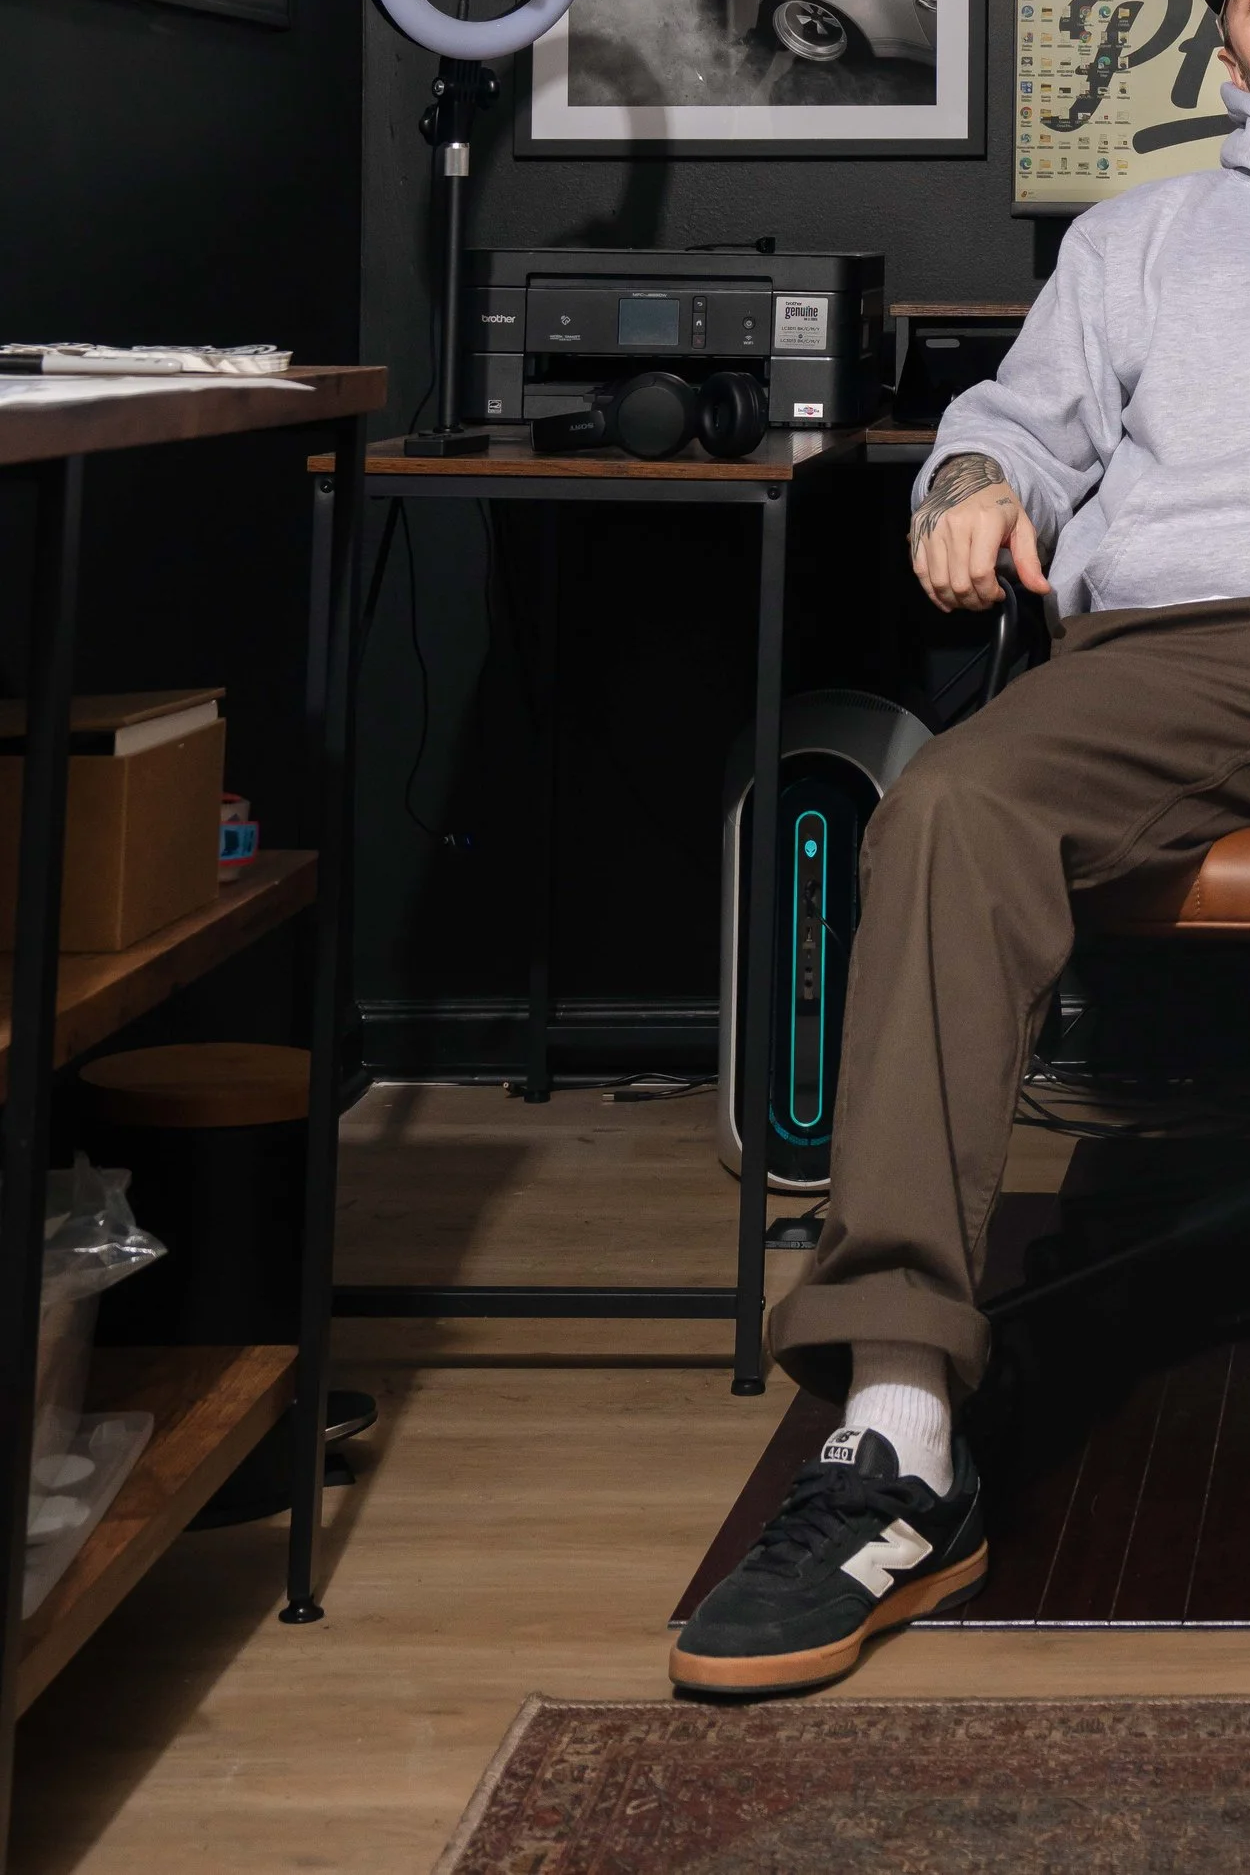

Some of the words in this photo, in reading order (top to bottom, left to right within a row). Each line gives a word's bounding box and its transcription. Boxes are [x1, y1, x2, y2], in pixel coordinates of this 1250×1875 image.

[482, 314, 516, 324] brother
[785, 306, 819, 320] genuine
[828, 1446, 849, 1460] 440
